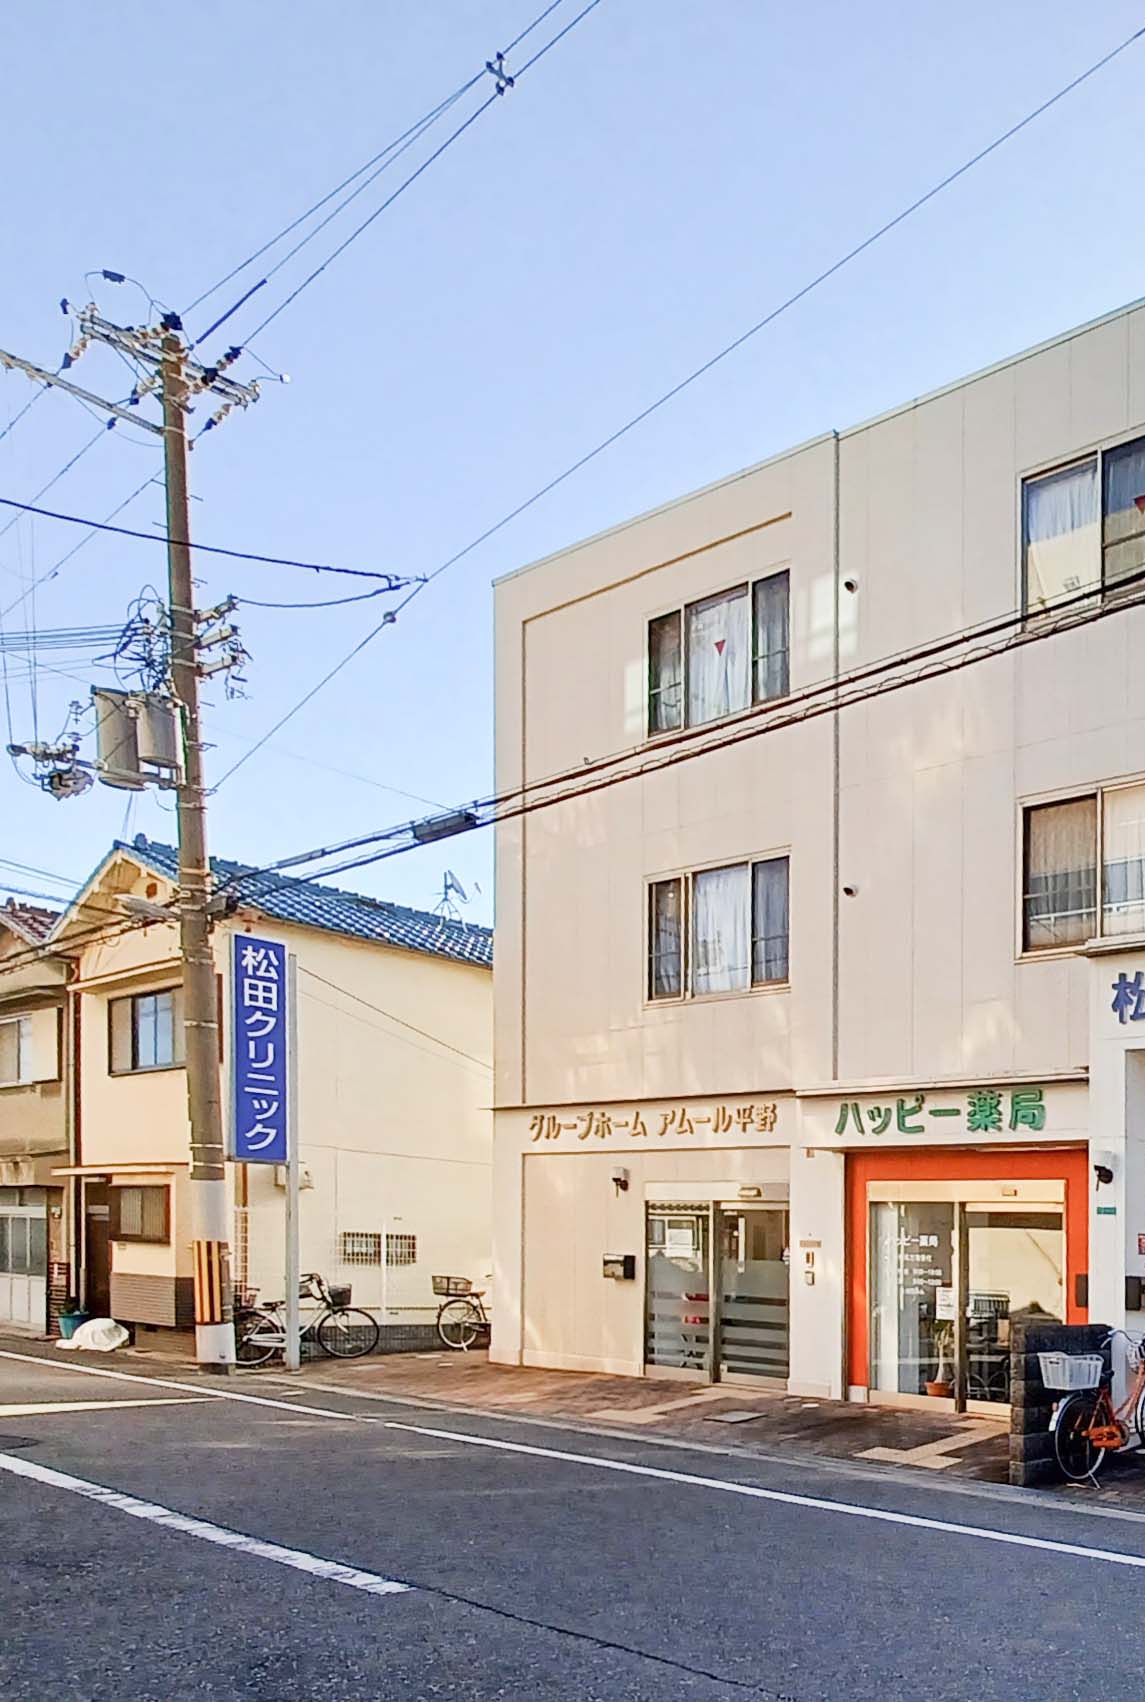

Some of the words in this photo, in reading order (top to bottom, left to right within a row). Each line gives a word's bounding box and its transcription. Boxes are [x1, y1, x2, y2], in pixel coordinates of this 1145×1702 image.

[241, 944, 280, 1152] 松田クリニック
[529, 1112, 648, 1142] グループホーム
[658, 1103, 777, 1136] アムール平野
[835, 1089, 1047, 1136] ハッピー薬局
